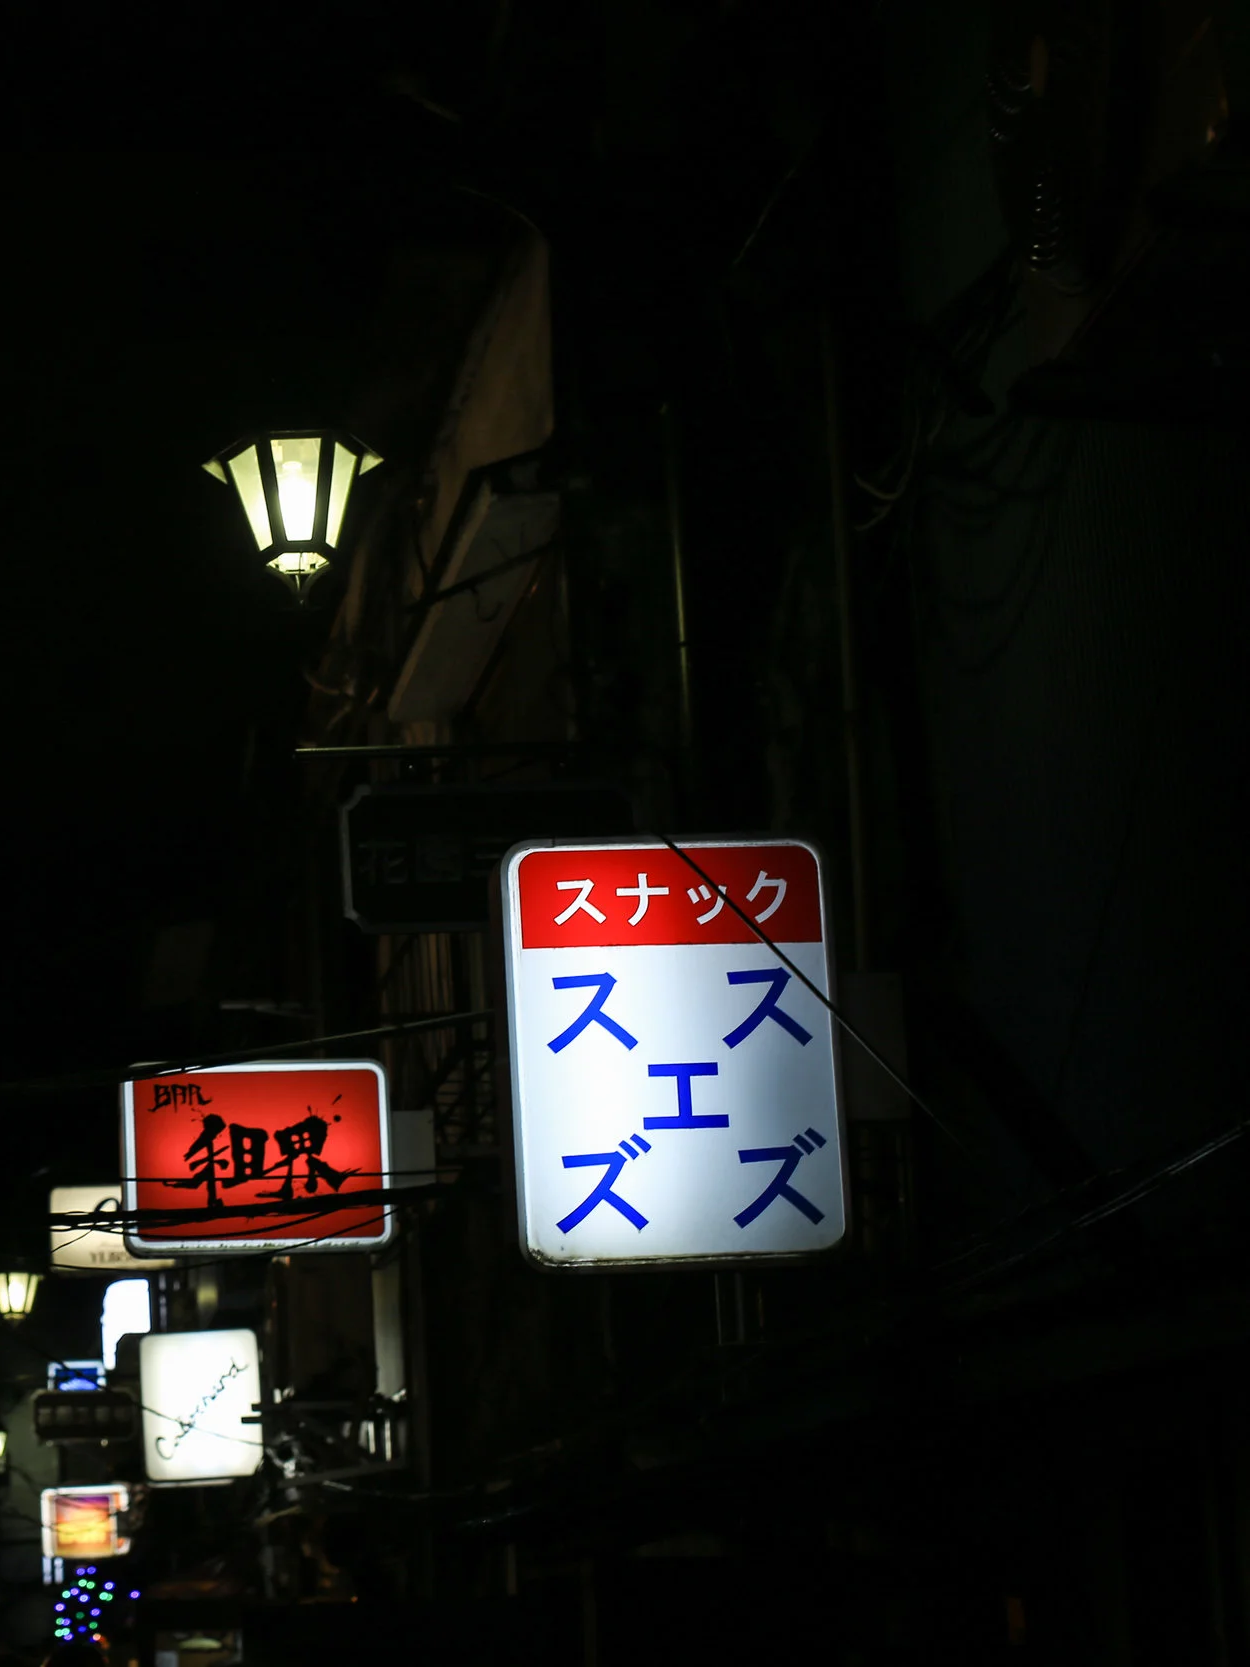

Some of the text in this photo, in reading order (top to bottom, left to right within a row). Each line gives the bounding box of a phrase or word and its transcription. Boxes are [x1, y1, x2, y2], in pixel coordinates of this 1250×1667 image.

[553, 870, 788, 927] スナック
[147, 1083, 213, 1112] BAR
[162, 1112, 361, 1207] 租界
